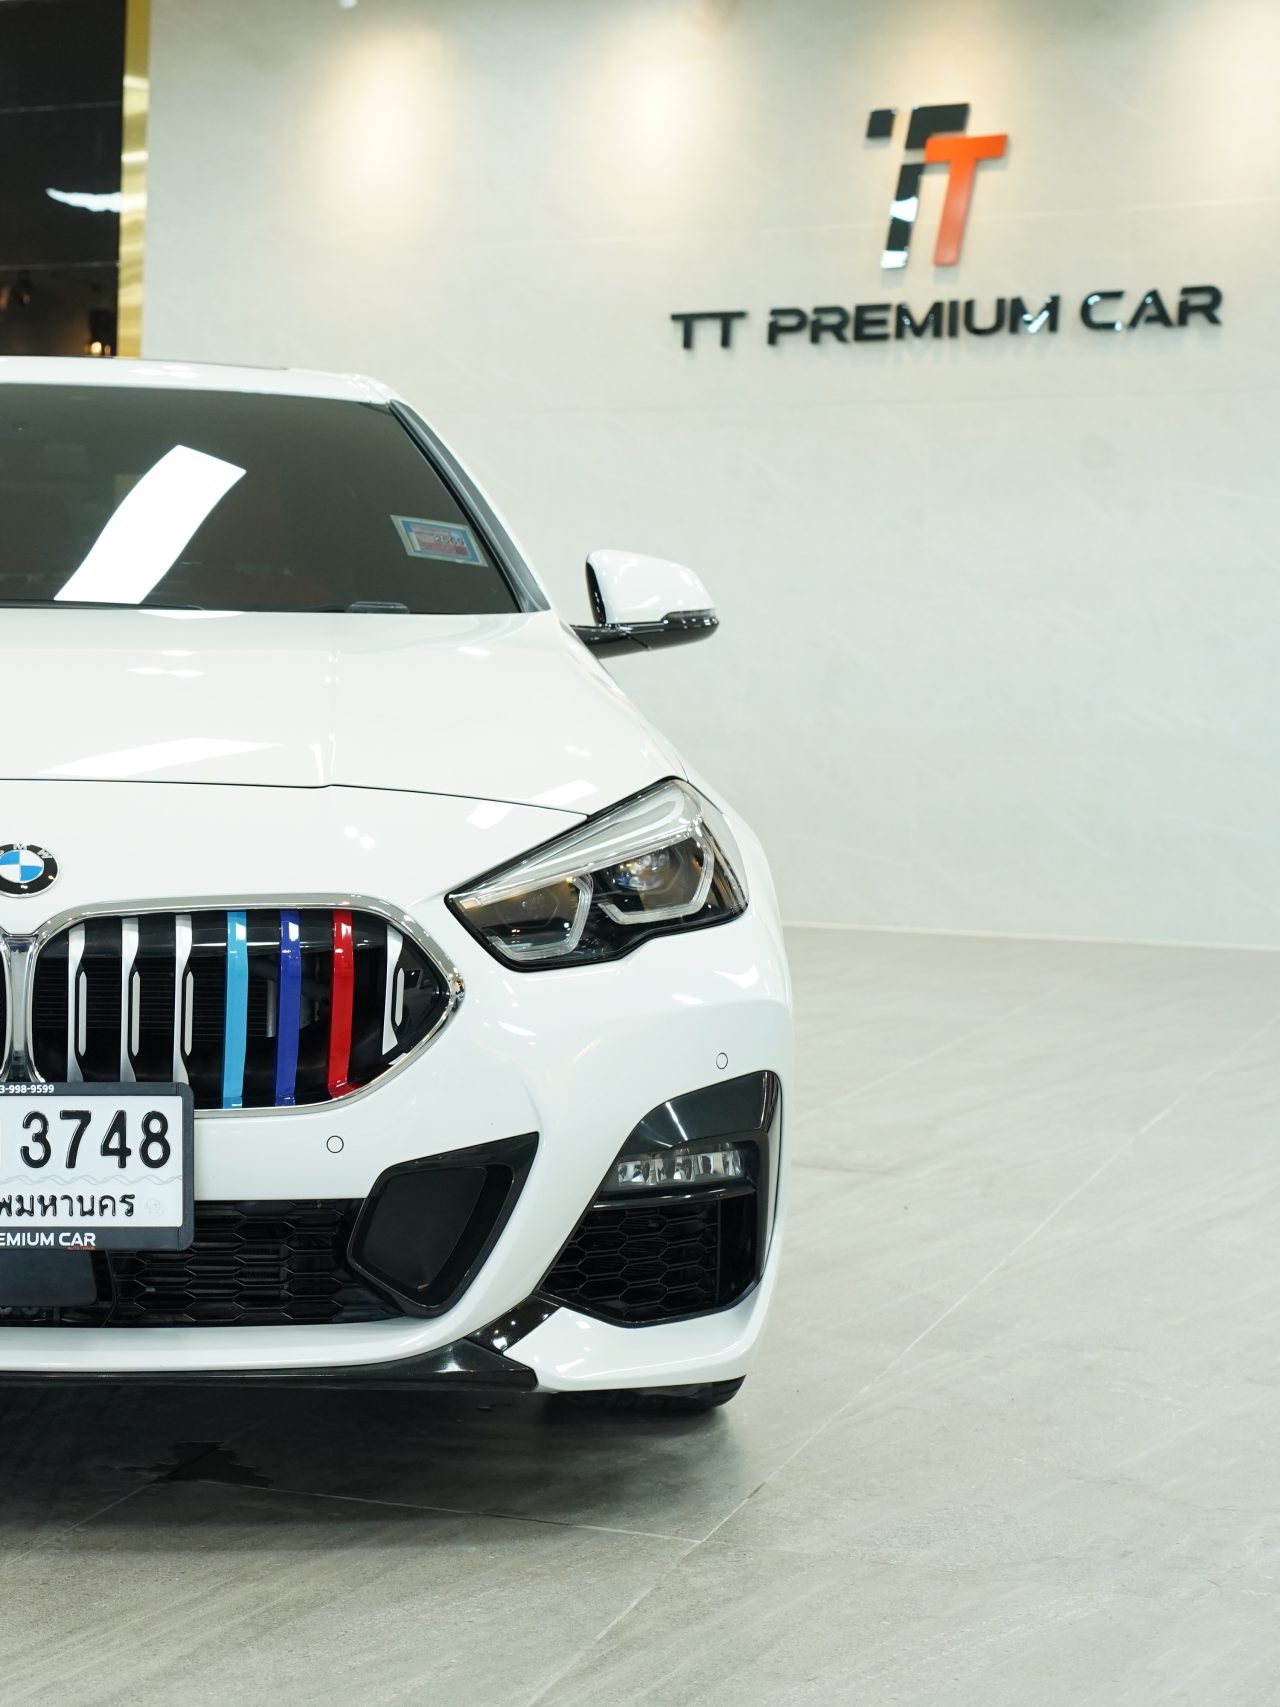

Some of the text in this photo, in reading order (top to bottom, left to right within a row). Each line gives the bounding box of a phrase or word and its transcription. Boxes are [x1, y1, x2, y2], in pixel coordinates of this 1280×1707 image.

[670, 284, 1223, 350] TT PREMIUM CAR
[20, 1109, 171, 1169] 3748
[58, 1232, 97, 1246] CAR
